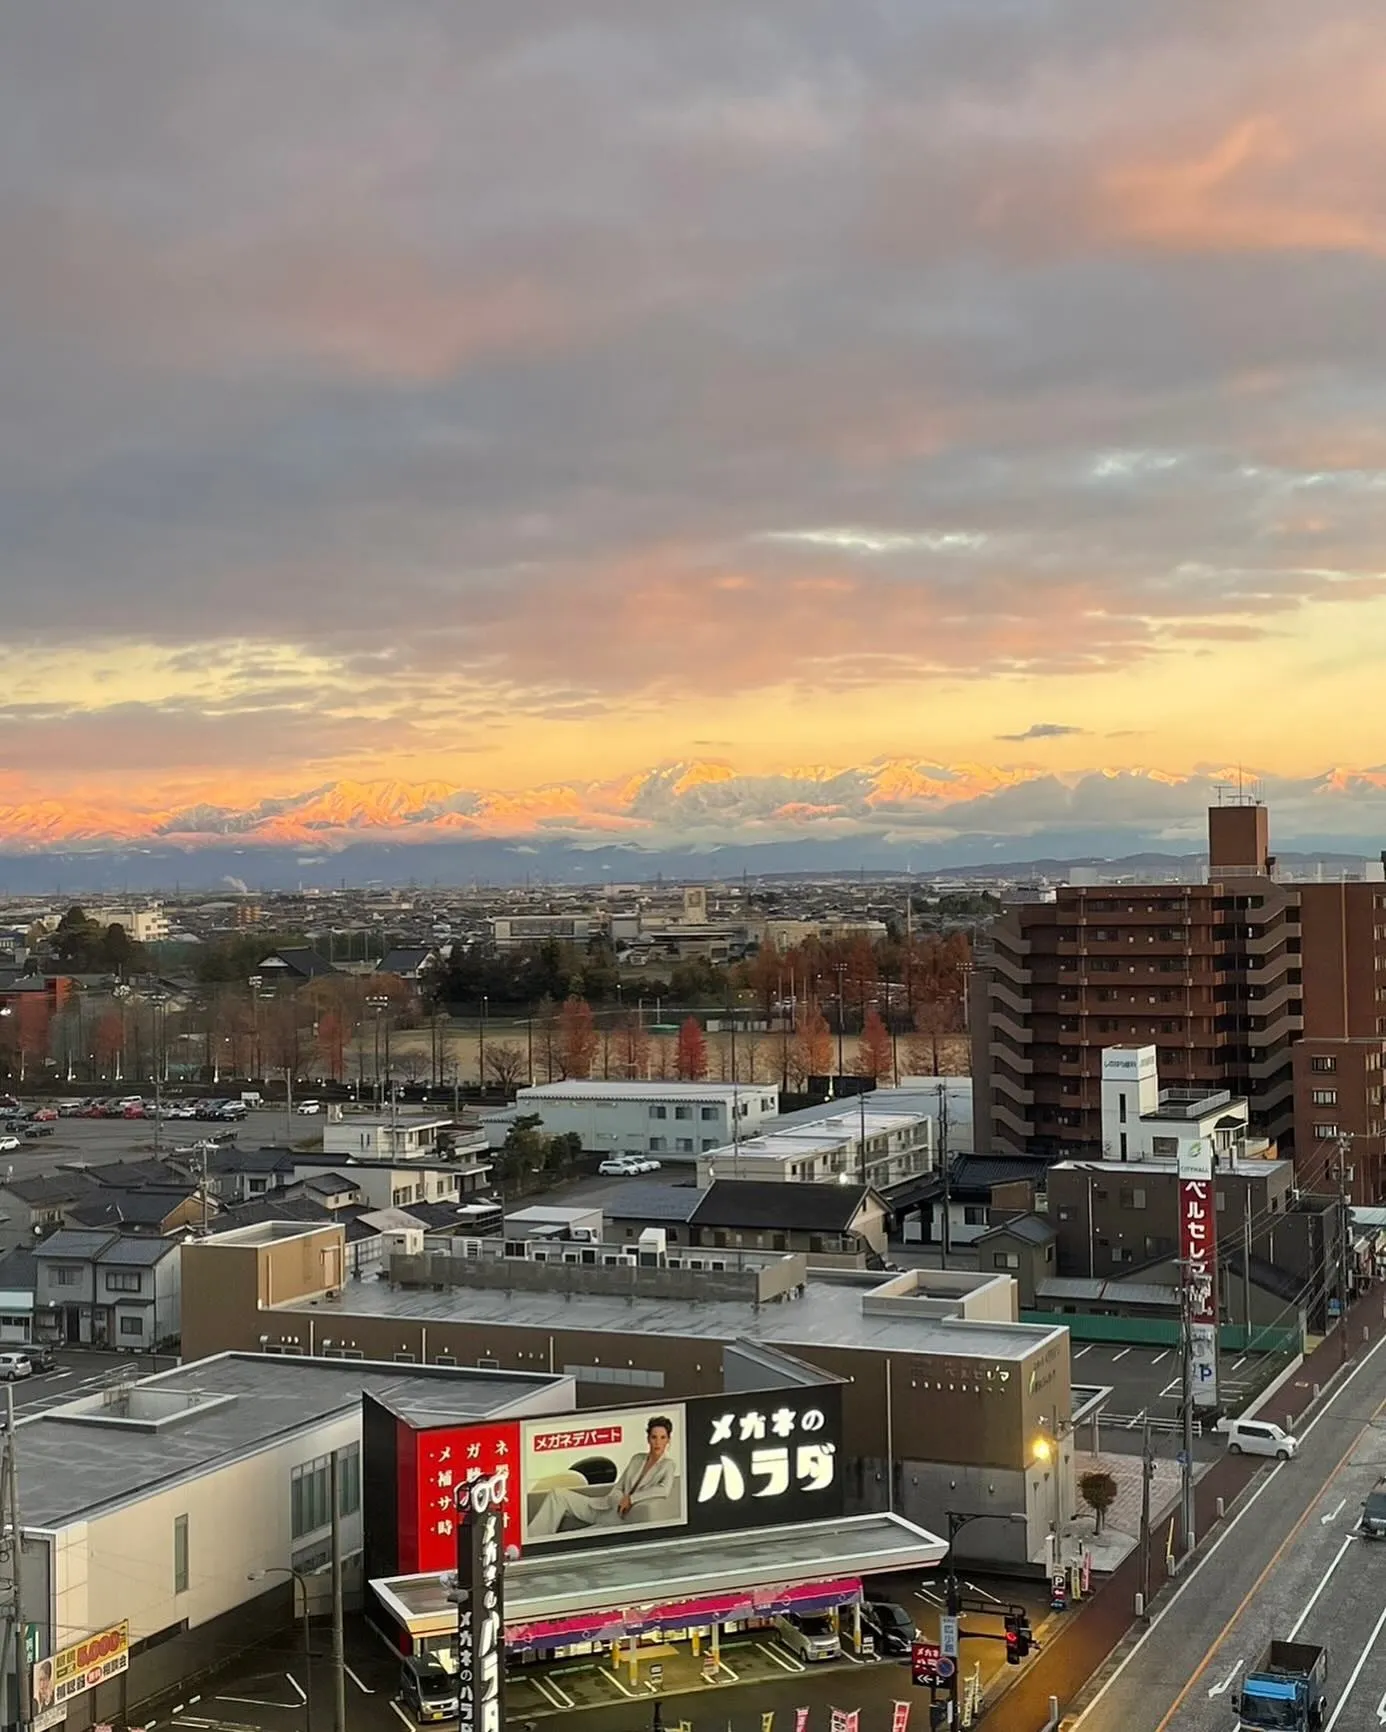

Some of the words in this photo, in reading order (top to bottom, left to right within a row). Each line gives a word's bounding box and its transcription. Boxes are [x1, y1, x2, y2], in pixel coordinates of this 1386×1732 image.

[535, 1429, 621, 1451] メガネデパート
[709, 1408, 825, 1445] メガネの
[438, 1440, 509, 1463] メガネ
[697, 1442, 836, 1502] ハラダ
